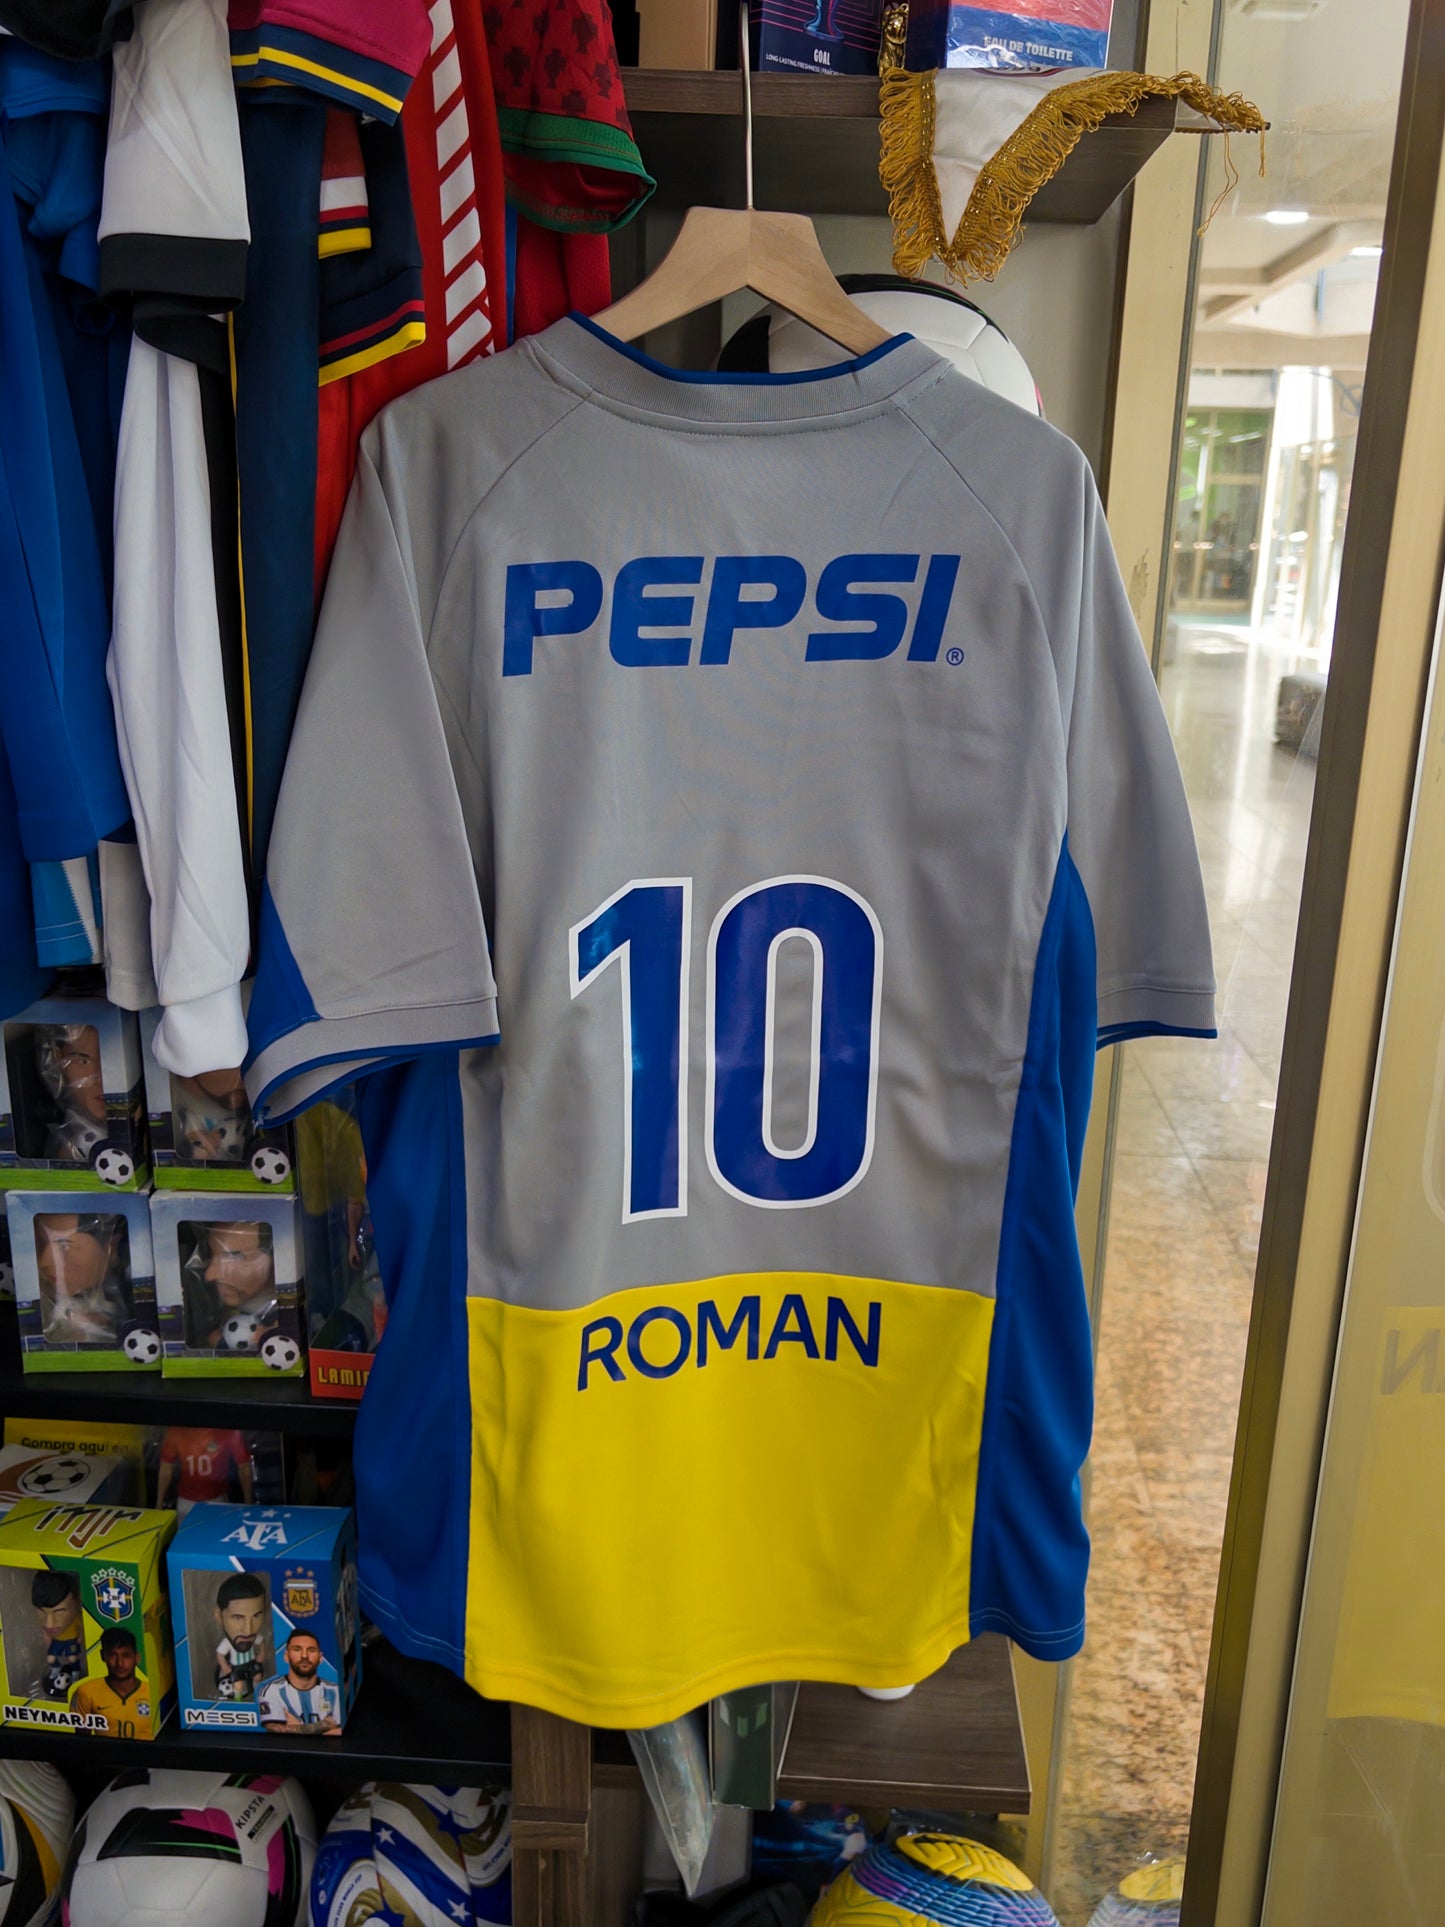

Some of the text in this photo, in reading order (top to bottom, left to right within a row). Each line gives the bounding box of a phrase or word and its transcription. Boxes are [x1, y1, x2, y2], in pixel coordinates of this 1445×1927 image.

[813, 48, 831, 66] GOAL
[1009, 40, 1024, 53] DE
[1026, 42, 1073, 62] TOILETTE
[503, 554, 961, 677] PEPSI
[568, 874, 884, 1225] 10
[577, 1293, 882, 1392] ROMAN
[21, 1437, 76, 1455] Compra
[79, 1442, 110, 1456] aqu
[186, 1454, 212, 1476] 10
[220, 1519, 288, 1551] AFA
[4, 1705, 108, 1730] NEYMAR JR
[116, 1719, 136, 1739] 10
[235, 1795, 265, 1829] KIPSTA
